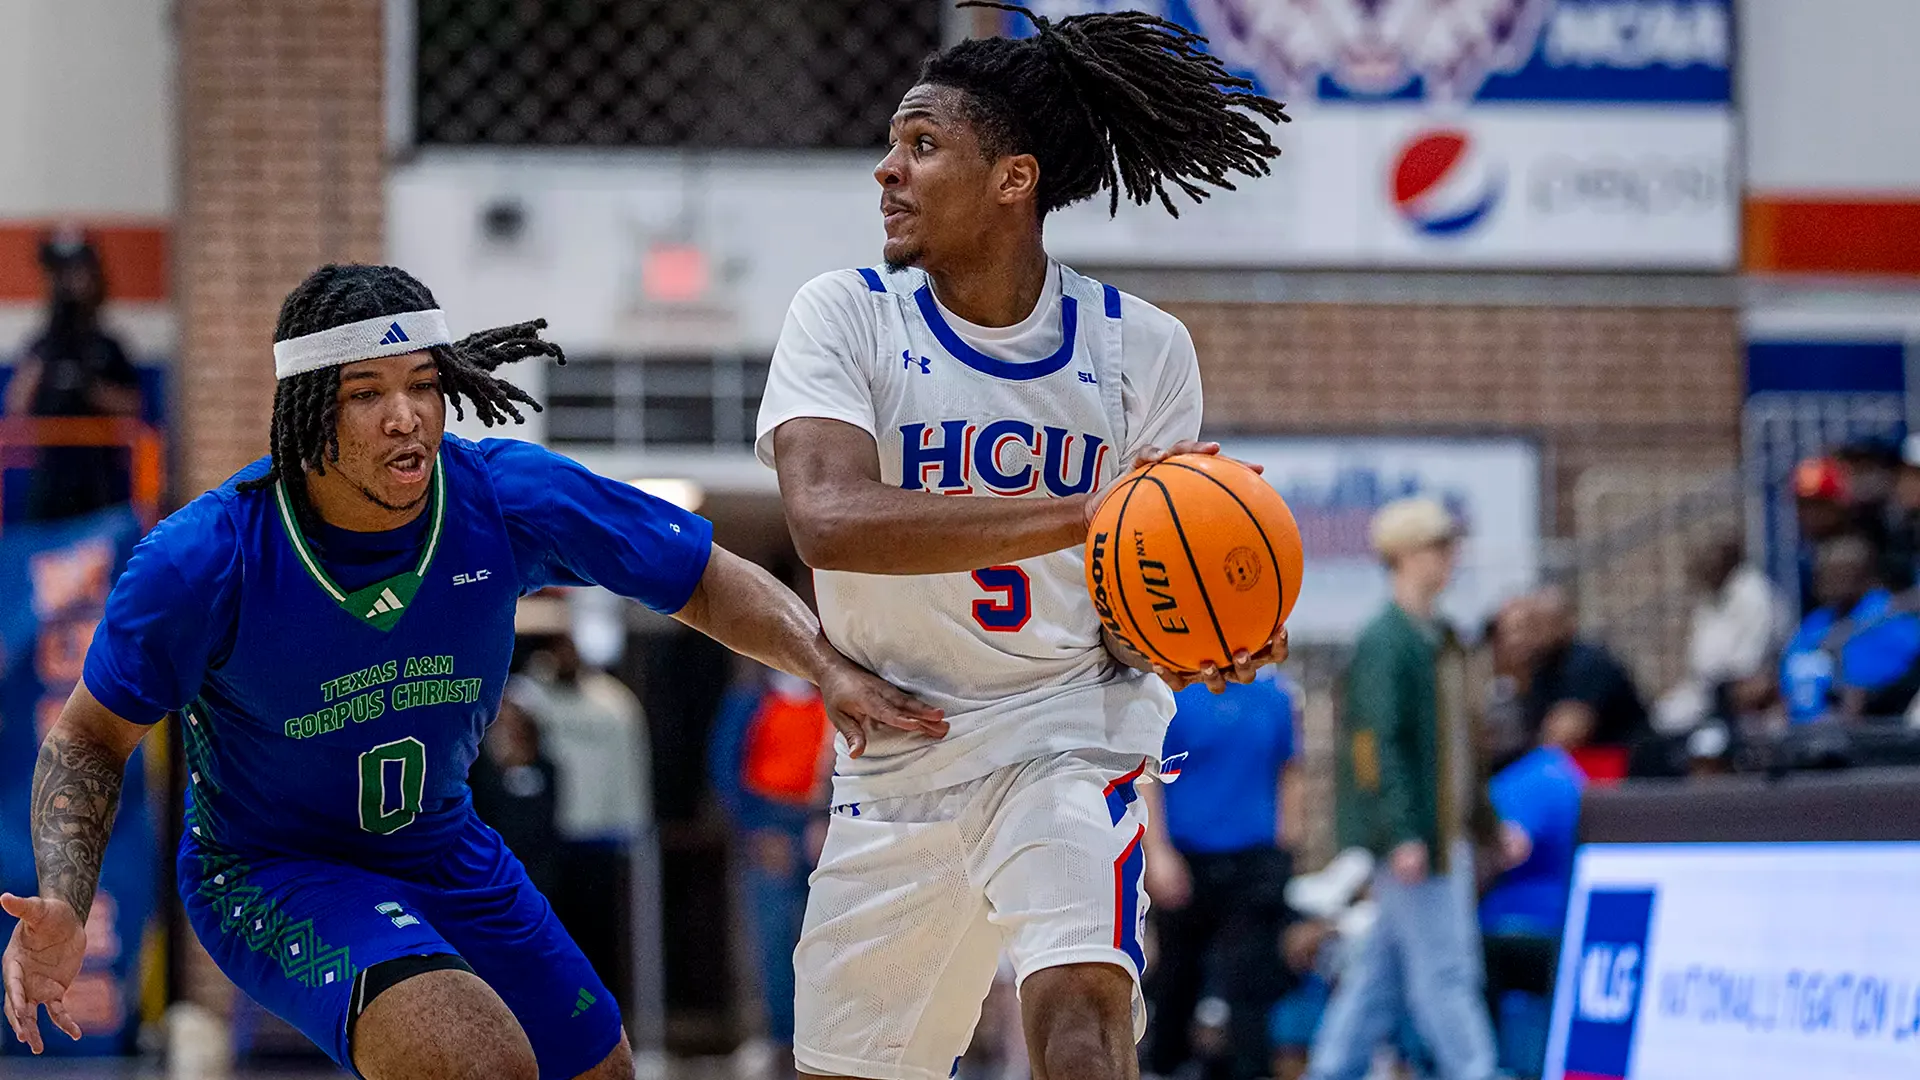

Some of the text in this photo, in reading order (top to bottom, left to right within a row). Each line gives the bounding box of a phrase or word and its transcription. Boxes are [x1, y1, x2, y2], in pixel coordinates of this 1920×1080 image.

[900, 420, 1109, 498] HCU
[1133, 529, 1147, 556] NXT
[452, 569, 491, 586] SLC
[1139, 560, 1190, 635] EVO
[284, 678, 482, 739] CORPUS CHRISTI
[321, 655, 453, 702] TEXAS A&M
[358, 736, 425, 835] 0
